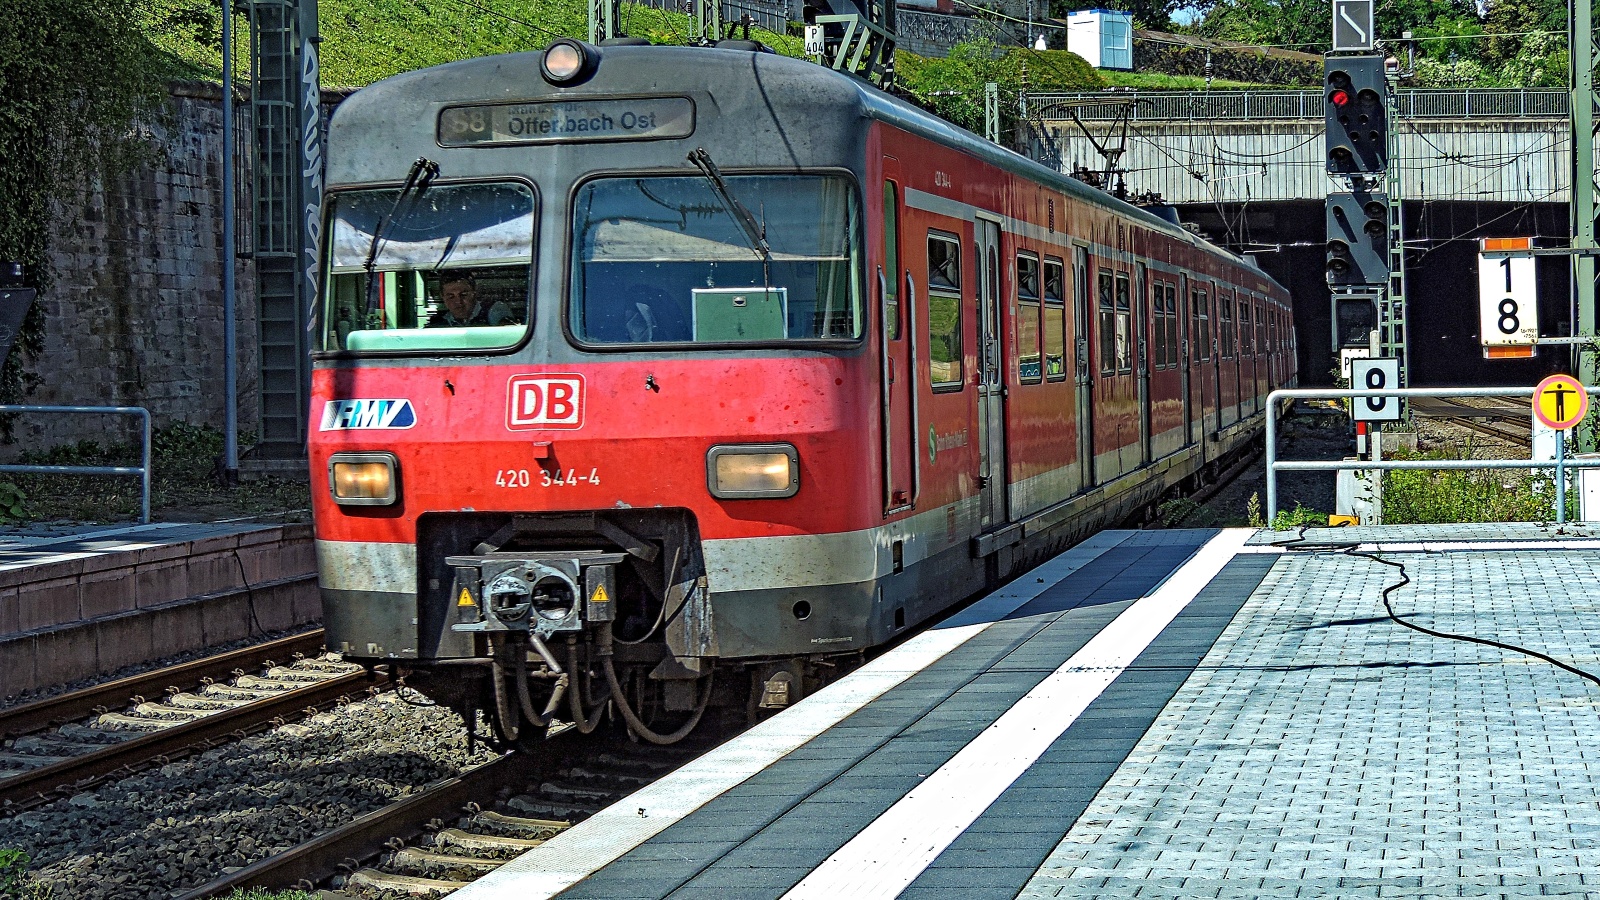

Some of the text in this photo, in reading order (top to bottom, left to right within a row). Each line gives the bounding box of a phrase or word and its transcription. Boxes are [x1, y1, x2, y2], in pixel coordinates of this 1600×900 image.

[811, 28, 817, 39] P
[806, 42, 823, 52] 404
[620, 111, 657, 130] Ost
[1499, 257, 1512, 293] 1
[1498, 298, 1520, 335] 8
[515, 382, 575, 421] DB
[328, 400, 412, 428] RMV
[495, 467, 601, 488] 420 344-4
